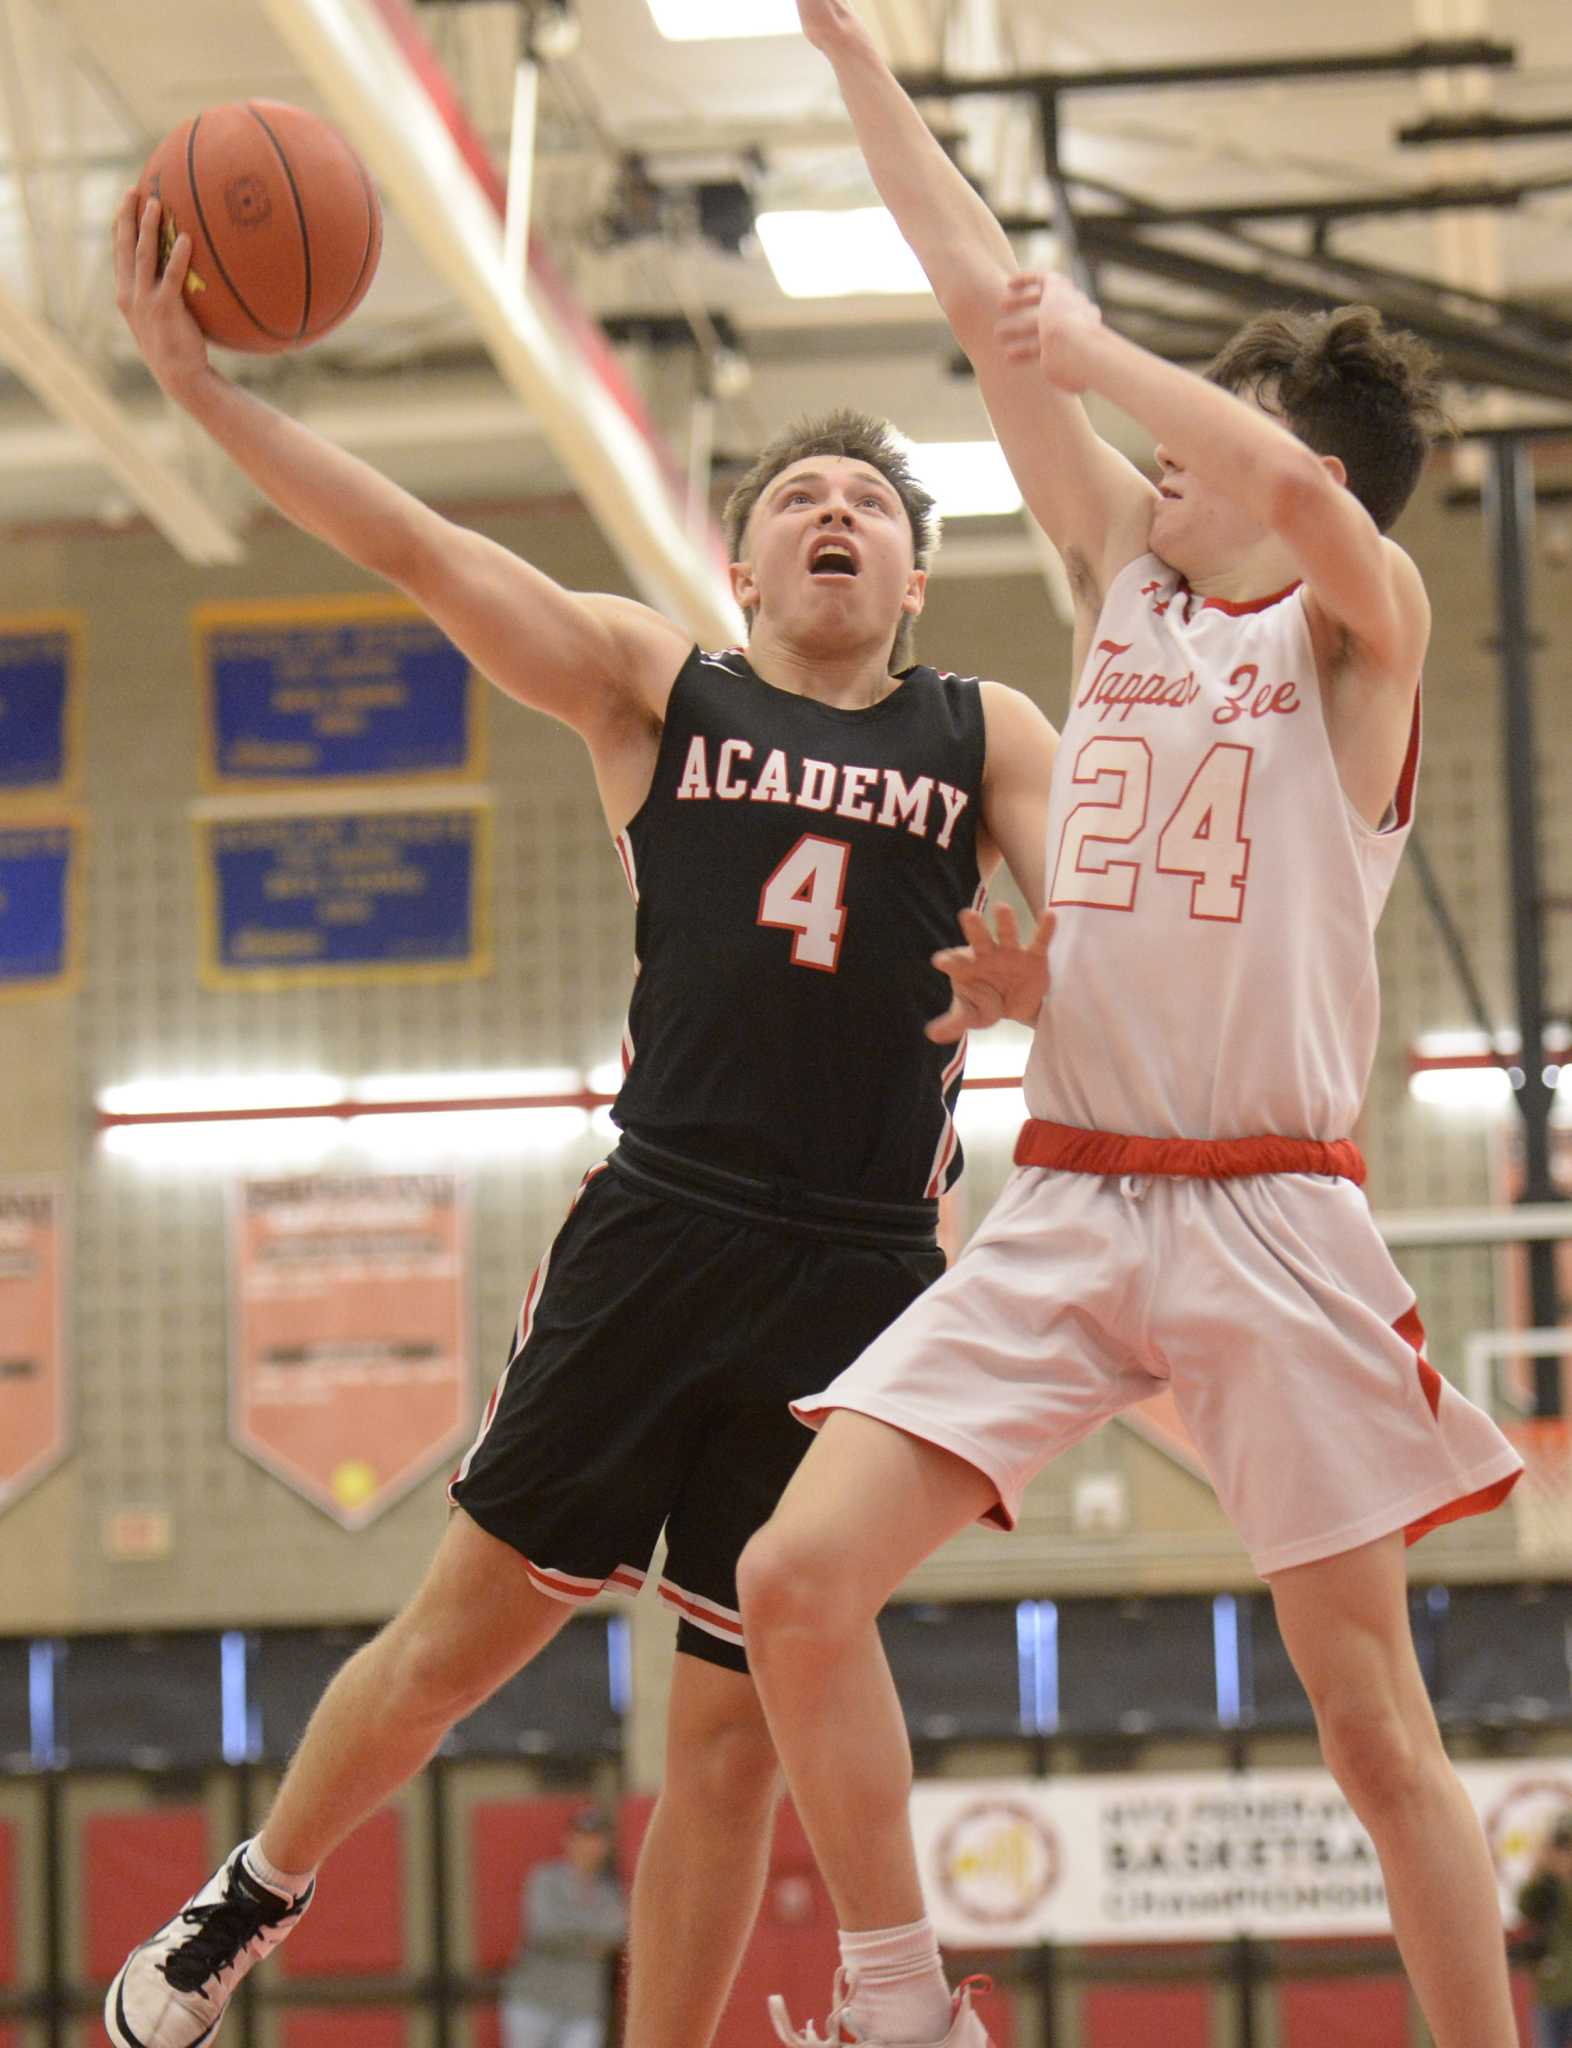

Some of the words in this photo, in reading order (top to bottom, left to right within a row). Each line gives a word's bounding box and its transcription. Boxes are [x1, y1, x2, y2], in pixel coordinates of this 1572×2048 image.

[1212, 663, 1301, 725] Zee
[676, 734, 969, 849] ACADEMY
[1048, 735, 1254, 923] 24
[756, 831, 852, 975] 4
